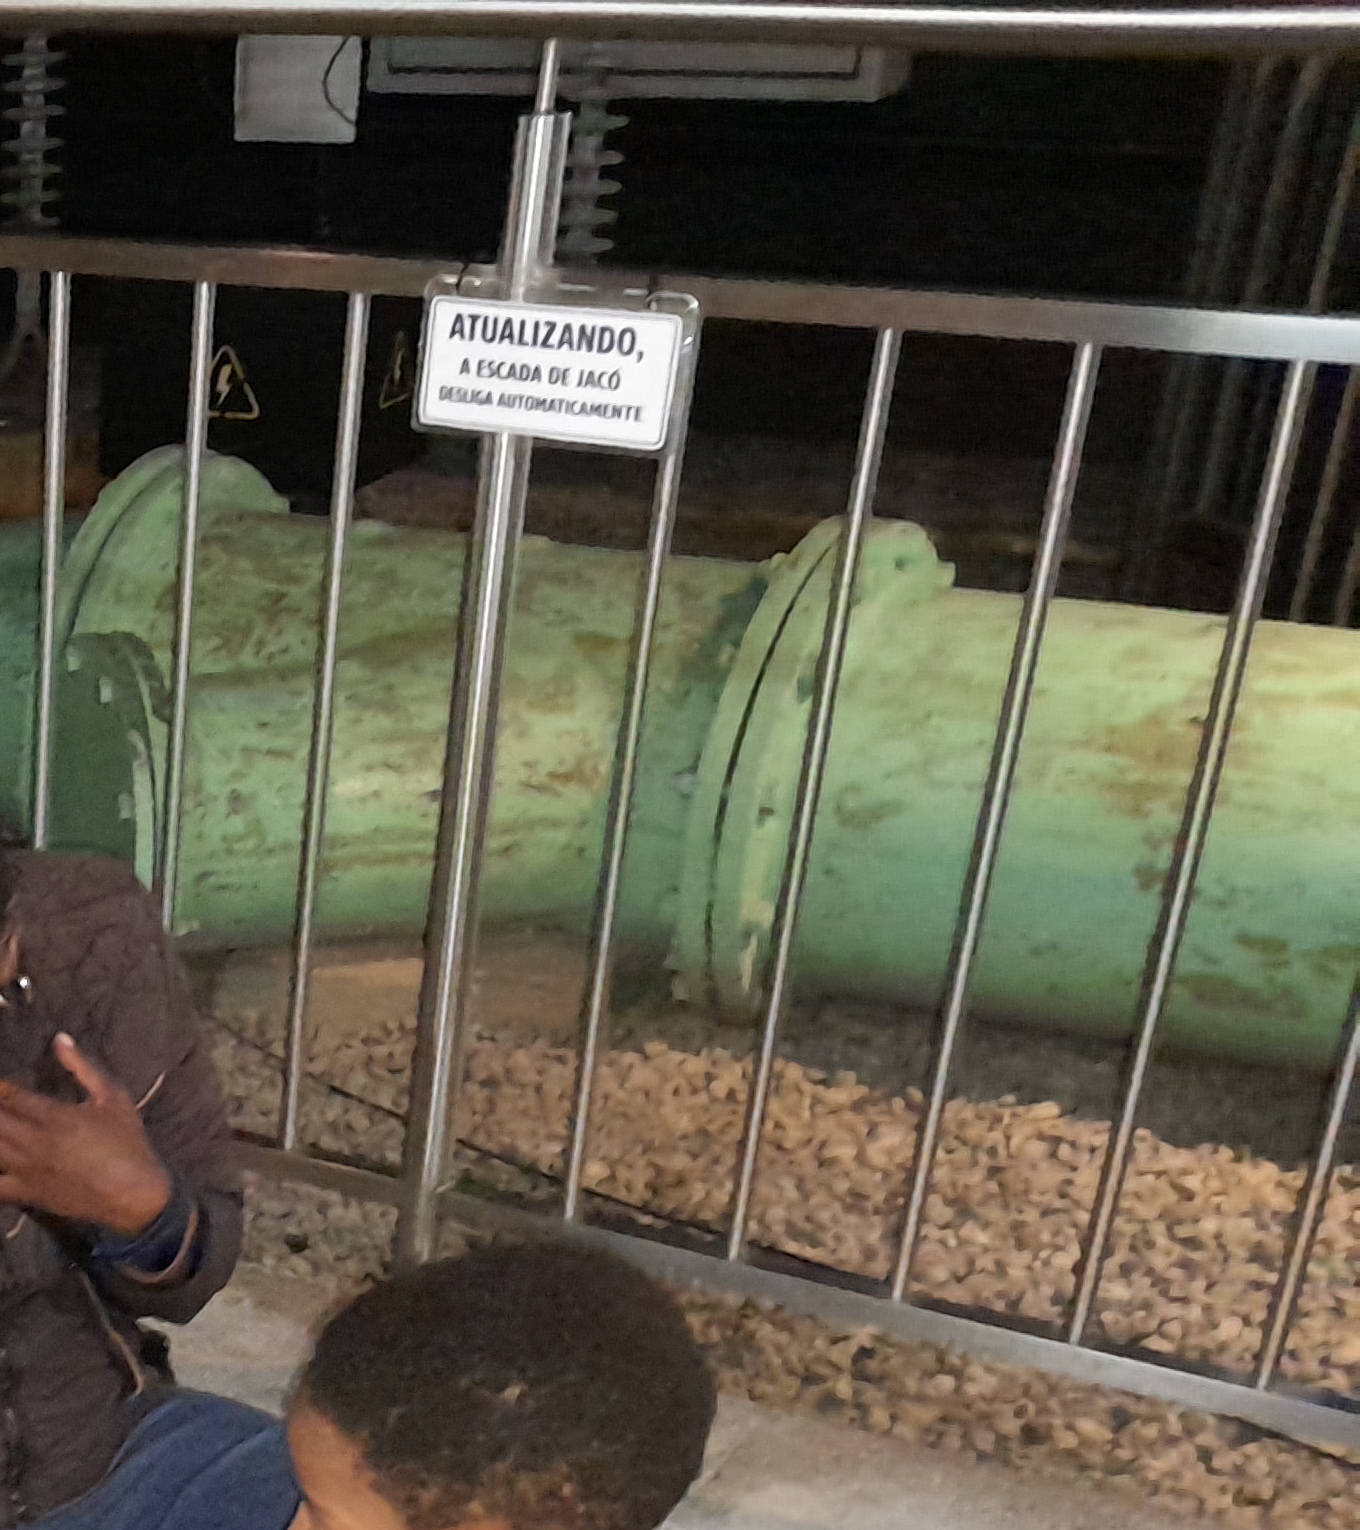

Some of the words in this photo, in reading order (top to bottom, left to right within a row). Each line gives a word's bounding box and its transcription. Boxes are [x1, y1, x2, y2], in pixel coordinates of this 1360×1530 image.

[448, 312, 644, 363] ATUALIZANDO,
[458, 357, 471, 376] A
[476, 358, 543, 383] ESCADA
[548, 365, 571, 387] DE
[576, 367, 622, 392] JACÓ
